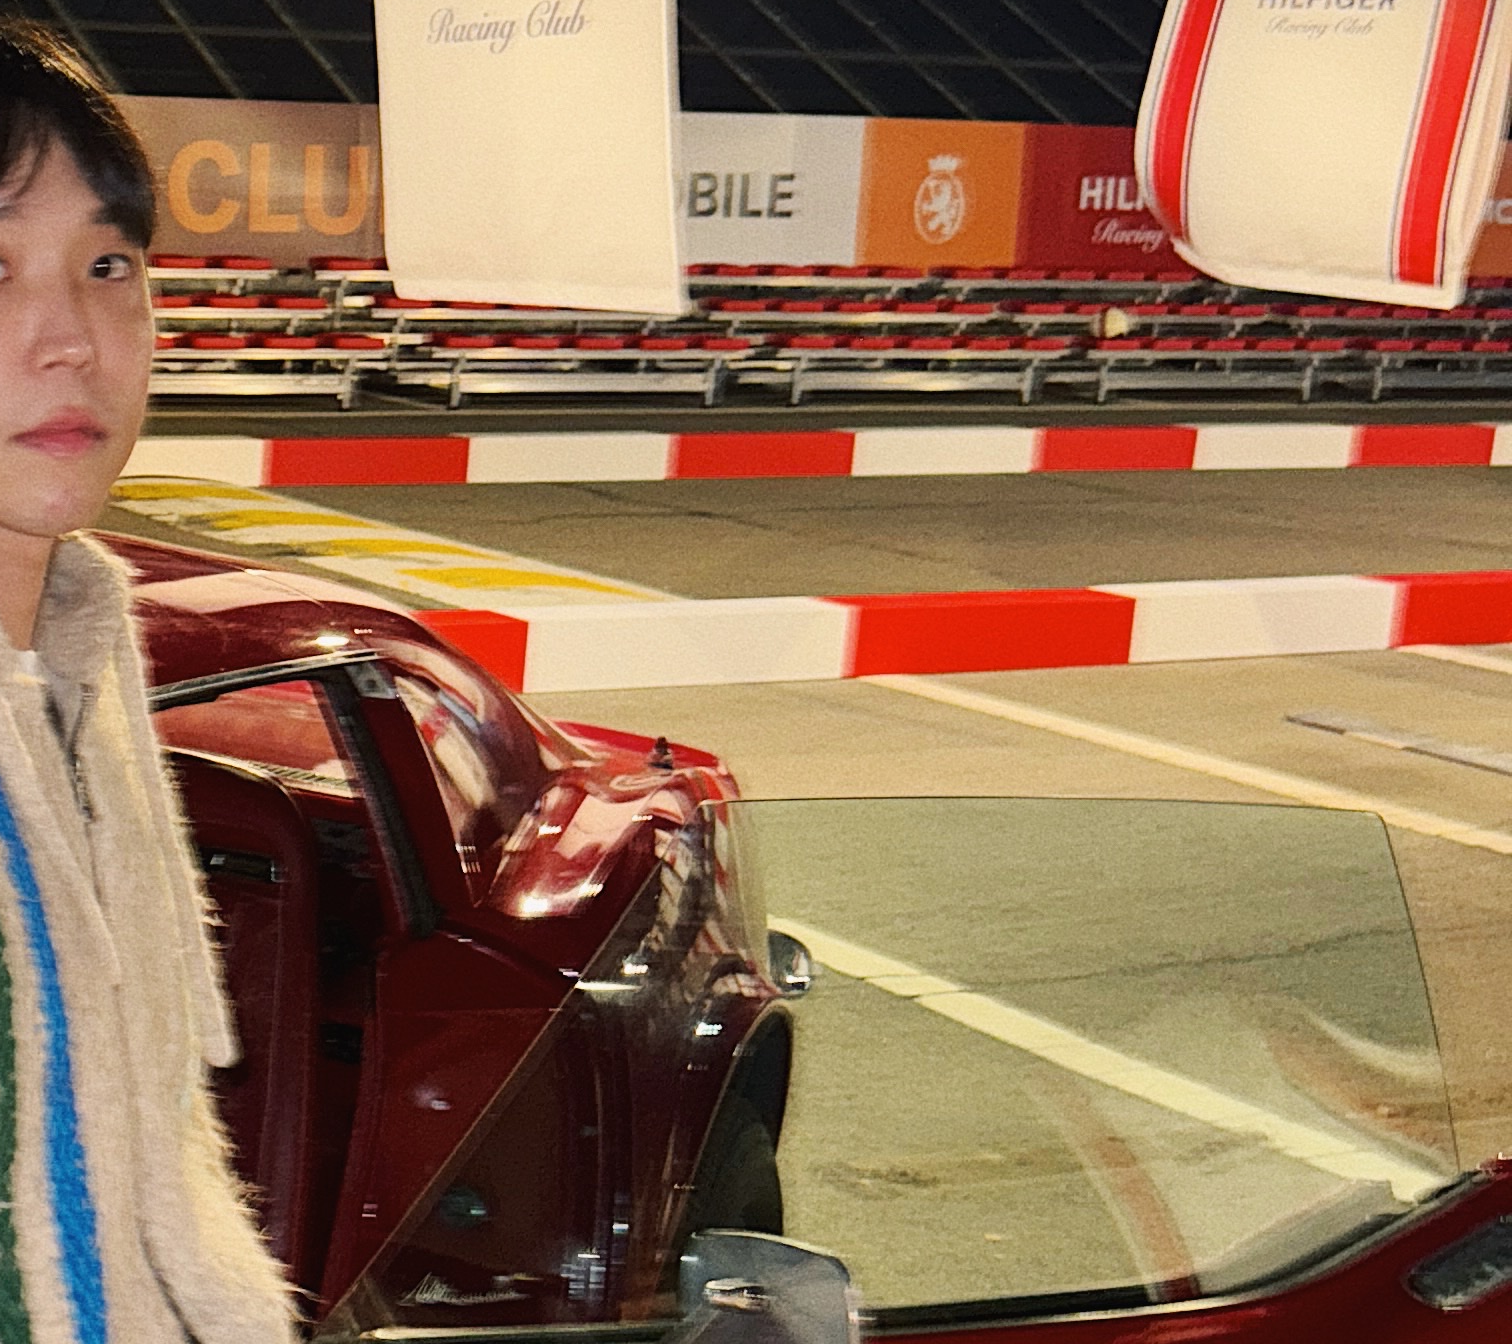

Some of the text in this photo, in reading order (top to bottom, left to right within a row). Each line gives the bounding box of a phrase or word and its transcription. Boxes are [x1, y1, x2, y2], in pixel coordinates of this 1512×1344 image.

[426, 7, 517, 54] Racing
[1265, 16, 1375, 40] Racing Club
[168, 139, 384, 236] CLU
[673, 172, 796, 218] BILE
[1091, 217, 1165, 253] Racing
